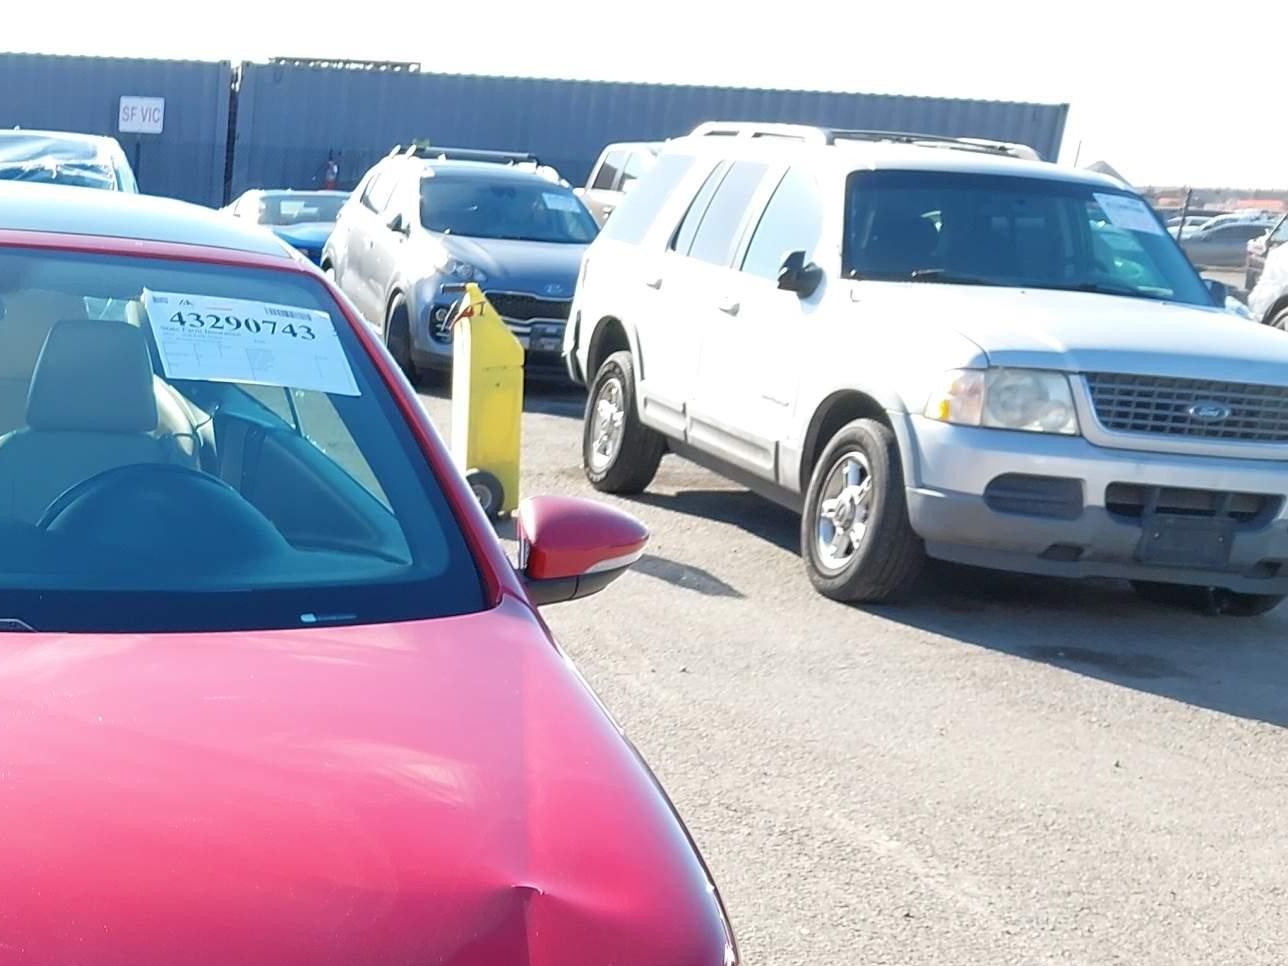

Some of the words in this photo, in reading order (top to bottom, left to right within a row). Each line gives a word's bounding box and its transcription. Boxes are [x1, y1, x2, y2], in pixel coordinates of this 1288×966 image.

[122, 105, 138, 122] SF
[140, 106, 160, 123] VIC
[169, 311, 316, 341] 43290743
